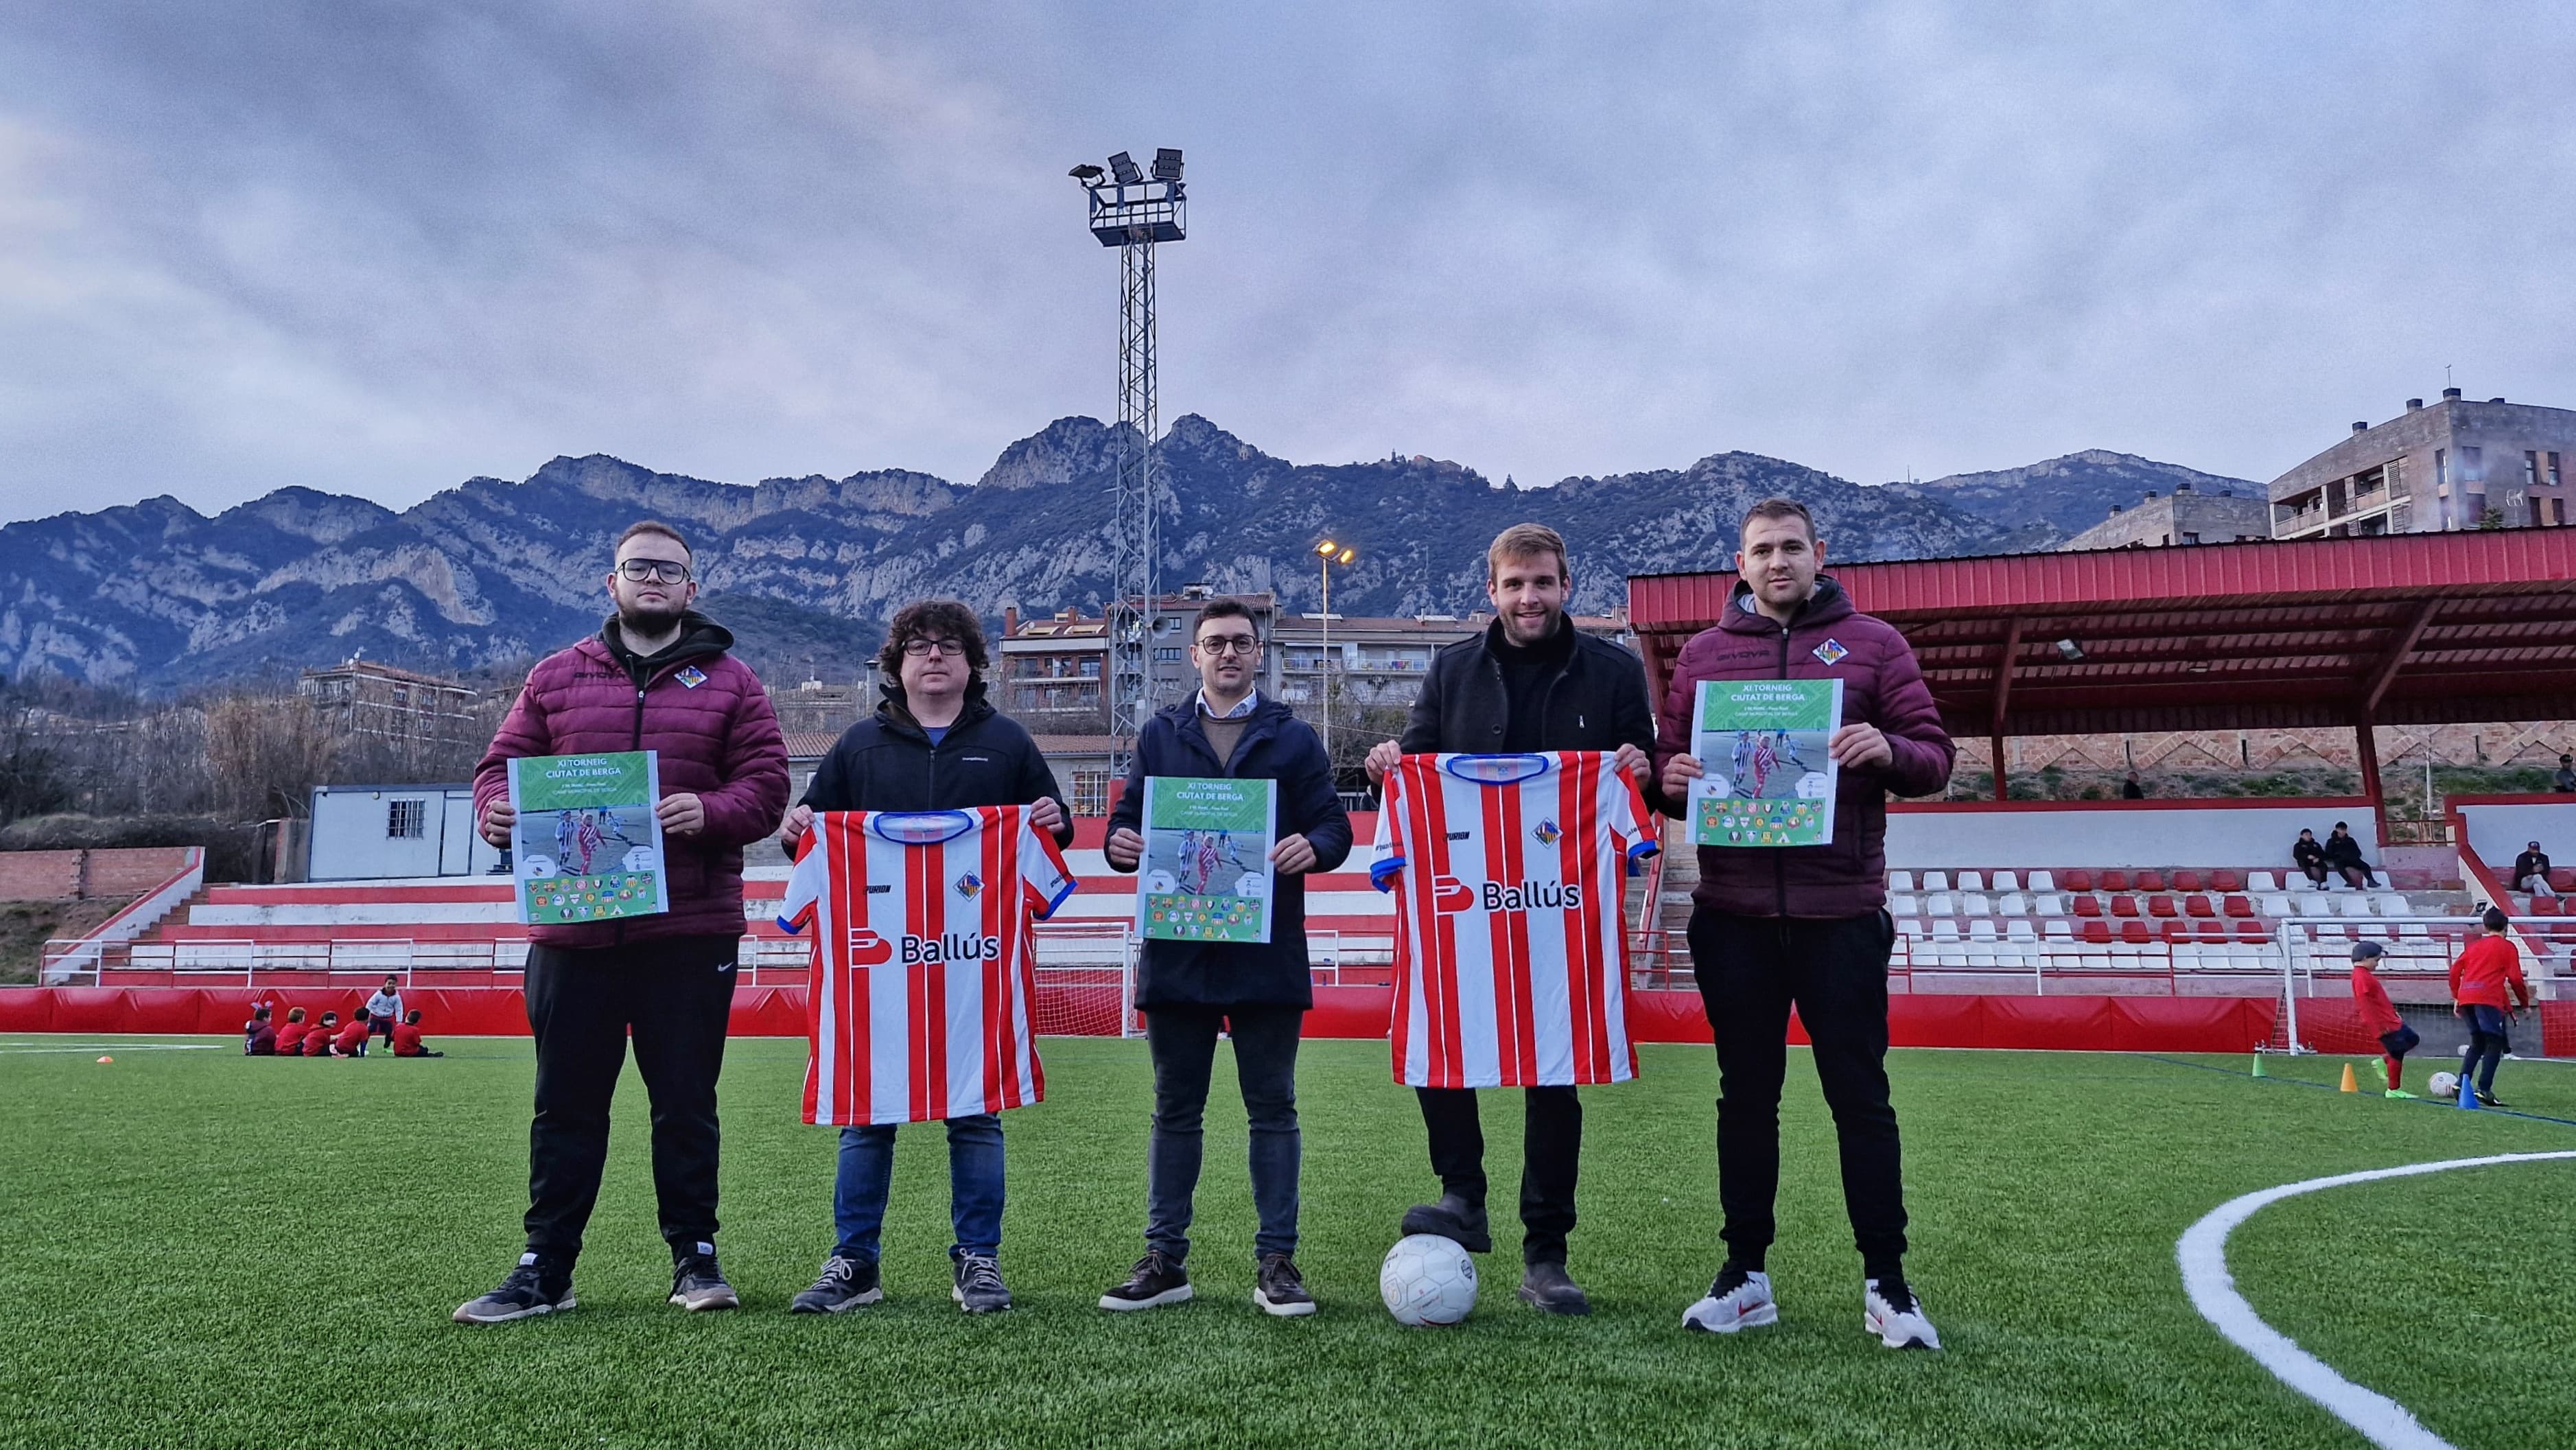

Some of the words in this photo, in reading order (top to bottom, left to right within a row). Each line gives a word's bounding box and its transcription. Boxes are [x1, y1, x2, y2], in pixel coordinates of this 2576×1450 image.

[1754, 683, 1792, 692] TORNEIG
[1776, 693, 1805, 701] BERGA
[557, 759, 565, 768] XI
[568, 758, 607, 767] TORNEIG
[546, 769, 576, 778] CIUTAT
[592, 767, 622, 776] BERGA
[1197, 782, 1232, 791] TORNEIG
[1177, 791, 1204, 800] CIUTAT
[1217, 793, 1243, 802] BERGA
[1482, 880, 1580, 911] Ballús
[901, 932, 999, 963] Ballús
